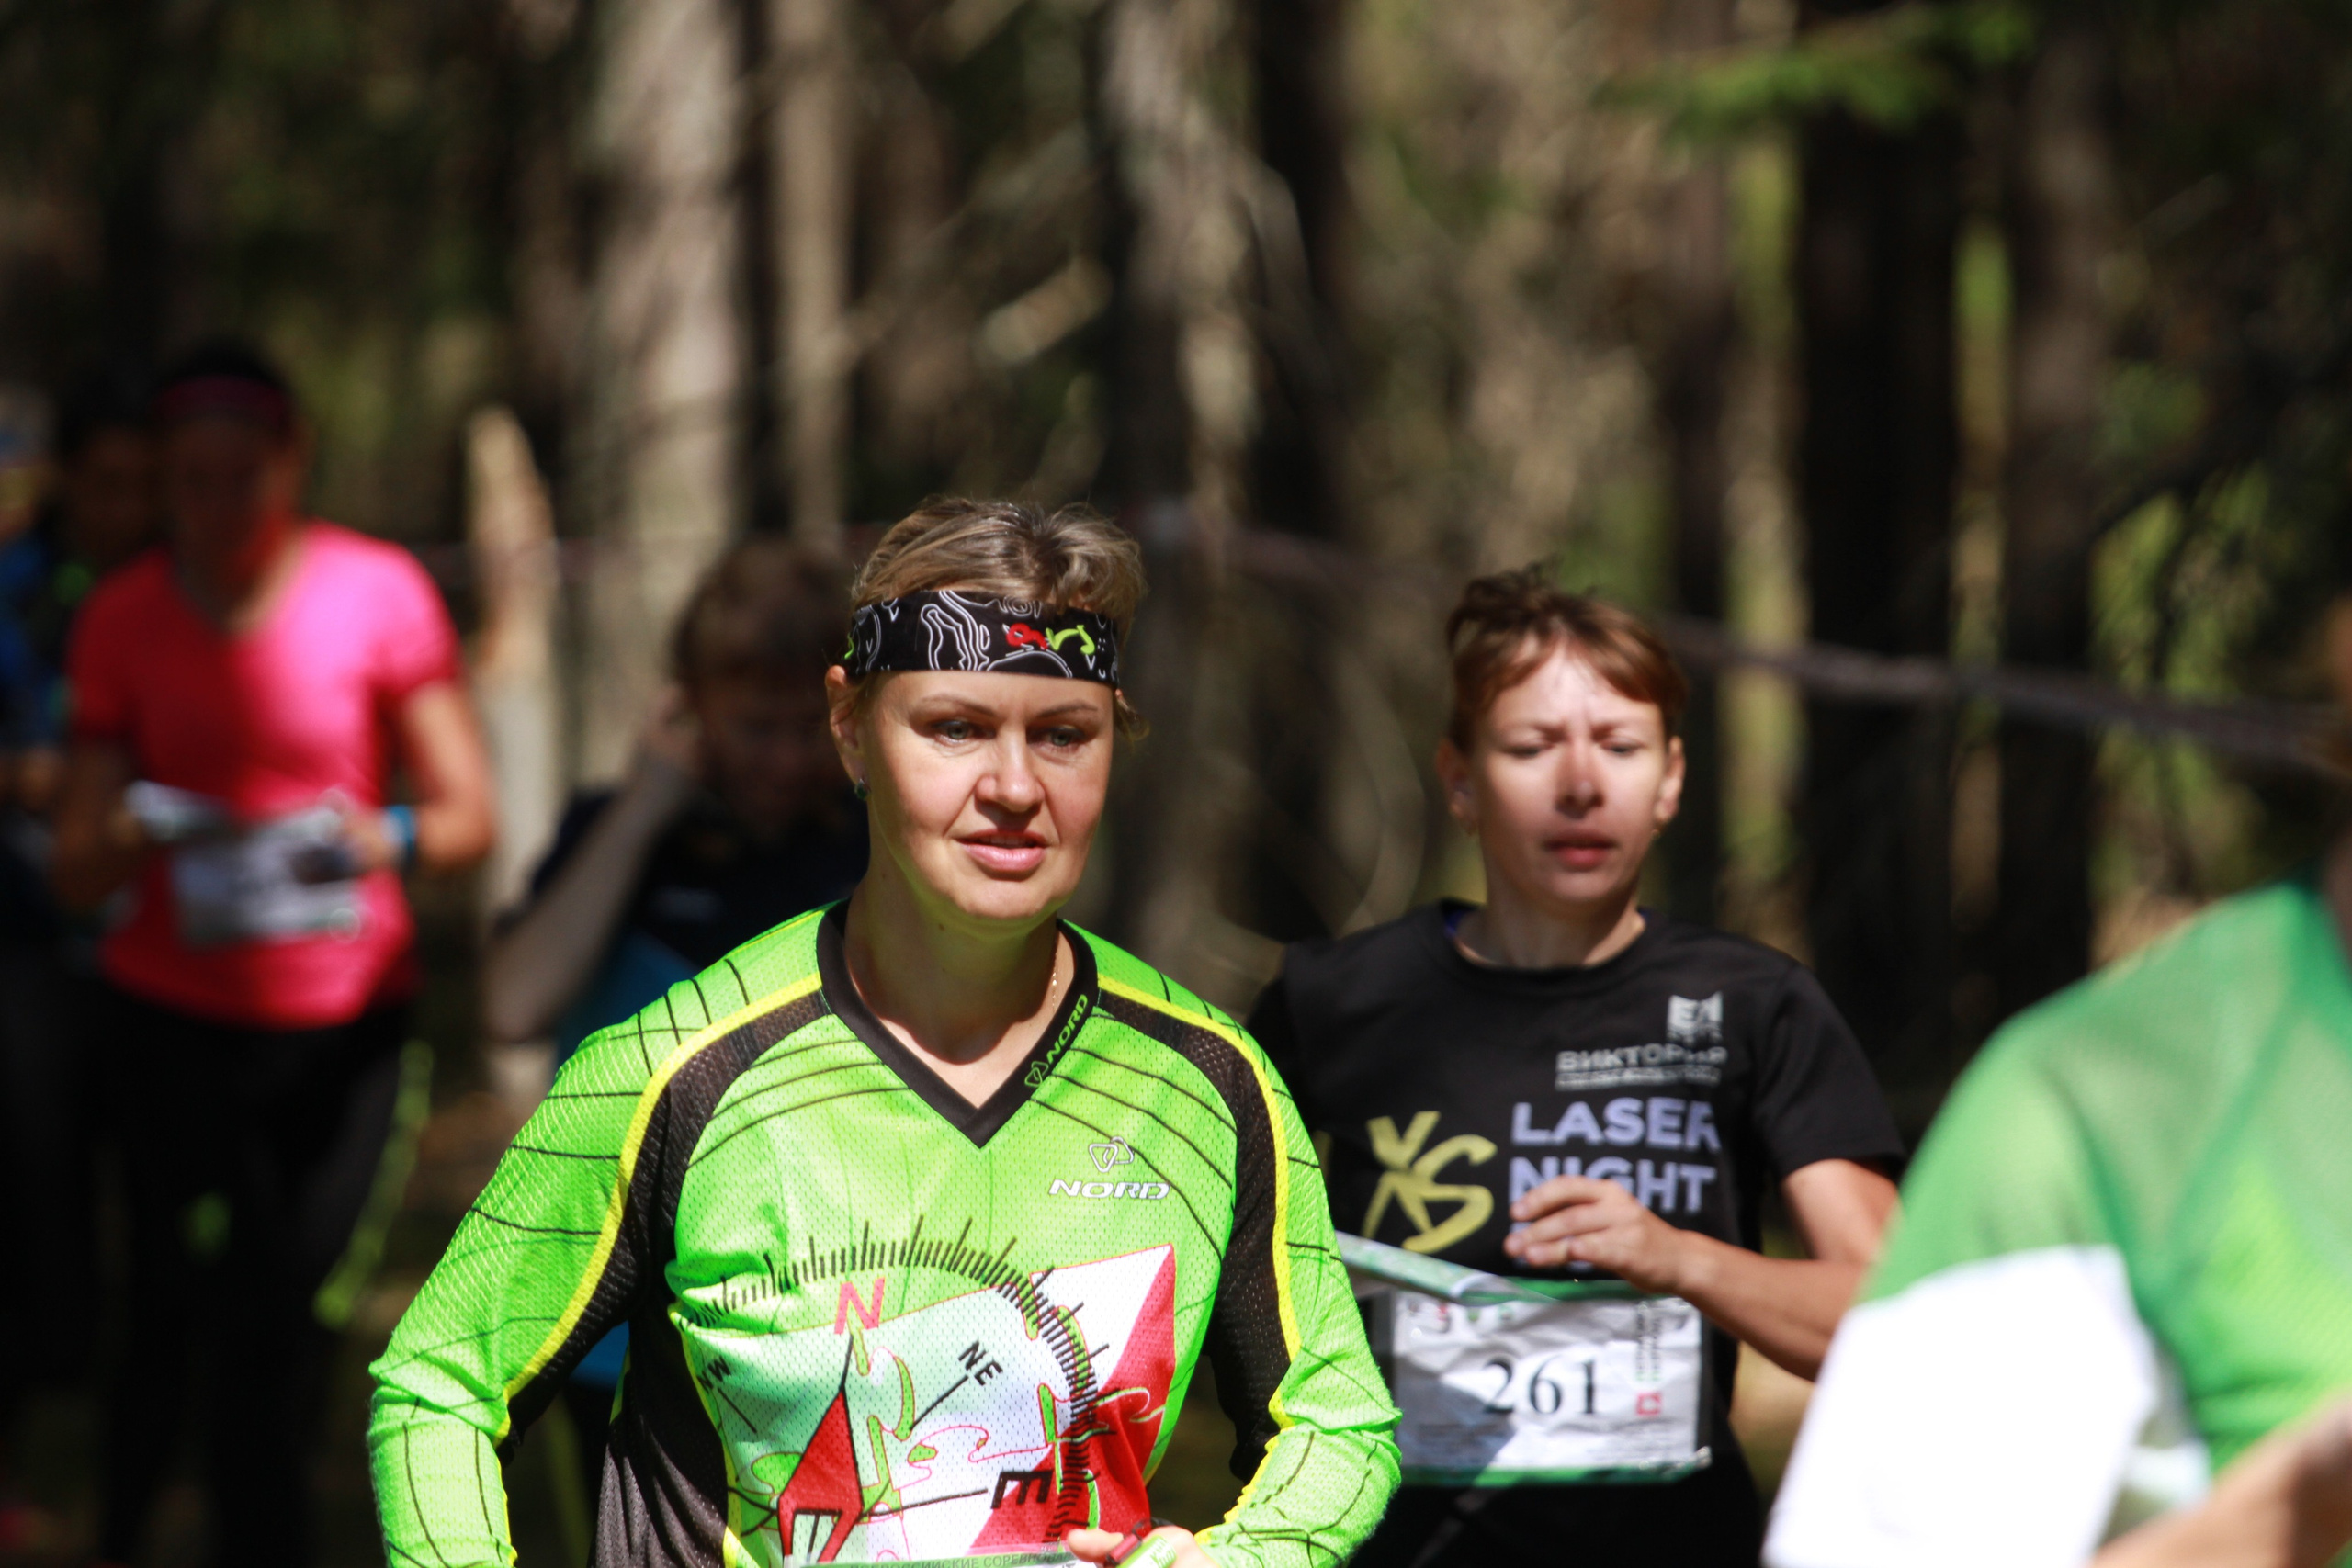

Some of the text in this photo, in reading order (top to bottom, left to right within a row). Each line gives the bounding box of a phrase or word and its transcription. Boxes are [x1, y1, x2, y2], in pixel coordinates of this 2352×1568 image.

[1046, 994, 1089, 1064] NORD
[1511, 1097, 1722, 1153] LASER
[1048, 1179, 1170, 1200] NORD
[833, 1277, 886, 1335] N
[958, 1340, 1003, 1386] NE
[1483, 1355, 1598, 1415] 261
